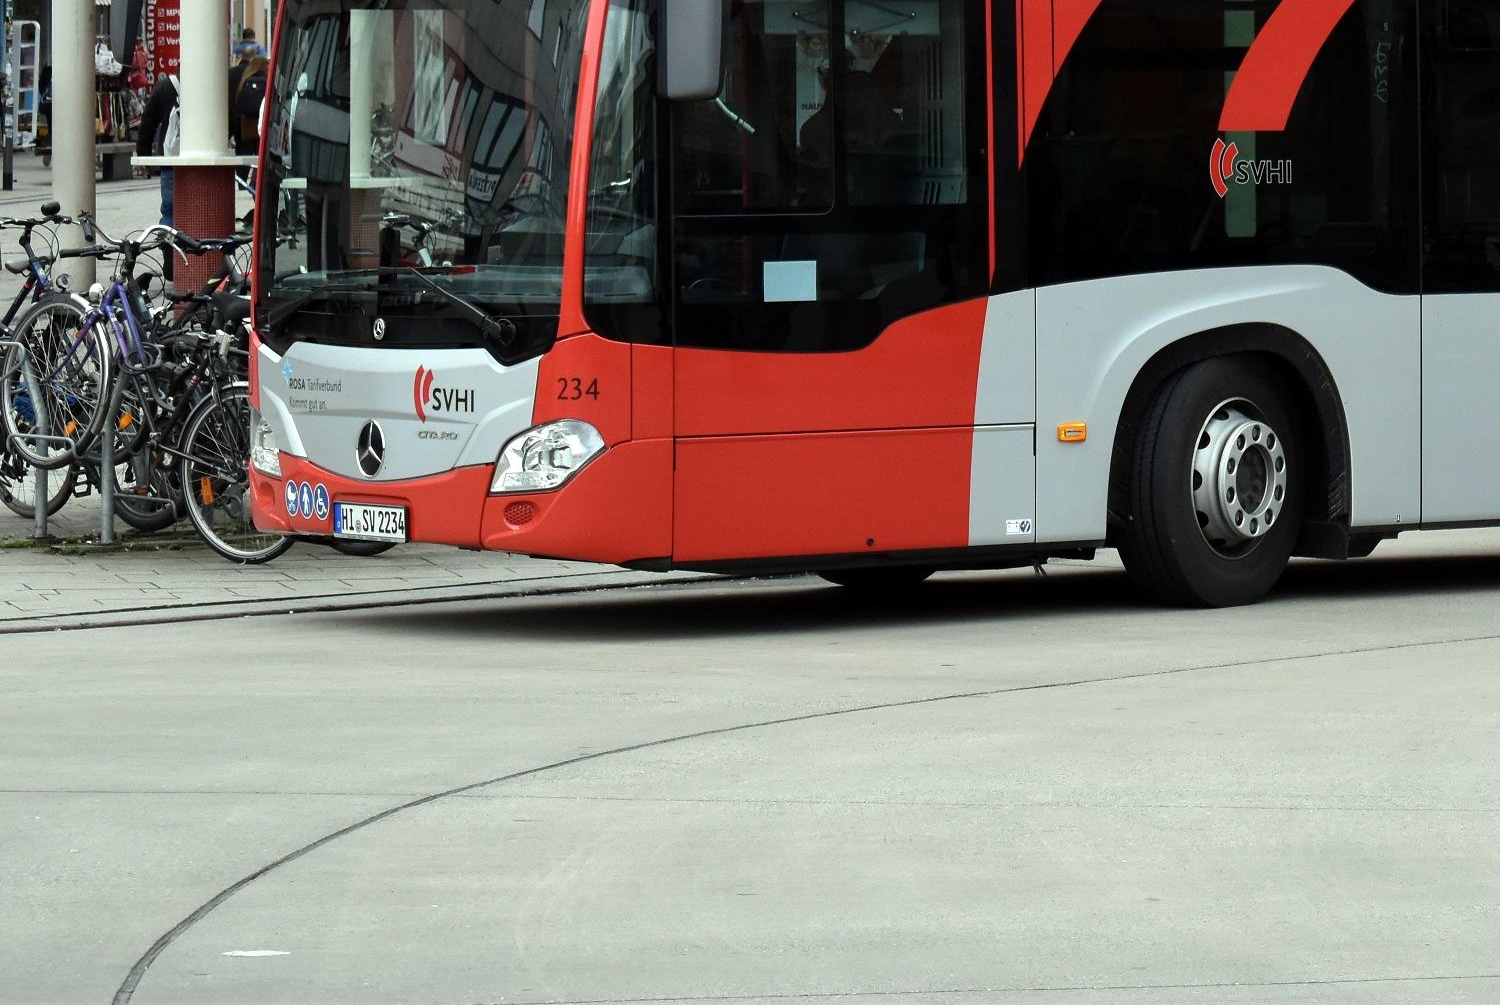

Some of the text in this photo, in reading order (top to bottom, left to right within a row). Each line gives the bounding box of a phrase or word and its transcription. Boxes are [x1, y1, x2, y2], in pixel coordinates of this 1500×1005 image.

[1235, 160, 1292, 184] SVHI
[289, 378, 342, 392] ROSA Tarifverbund
[557, 378, 600, 400] 234
[289, 396, 307, 409] Kommt
[308, 400, 318, 412] gut
[432, 387, 475, 412] SVHI
[418, 430, 457, 440] CITARO
[342, 508, 354, 531] HI
[362, 509, 375, 533] SV
[378, 511, 405, 535] 2234
